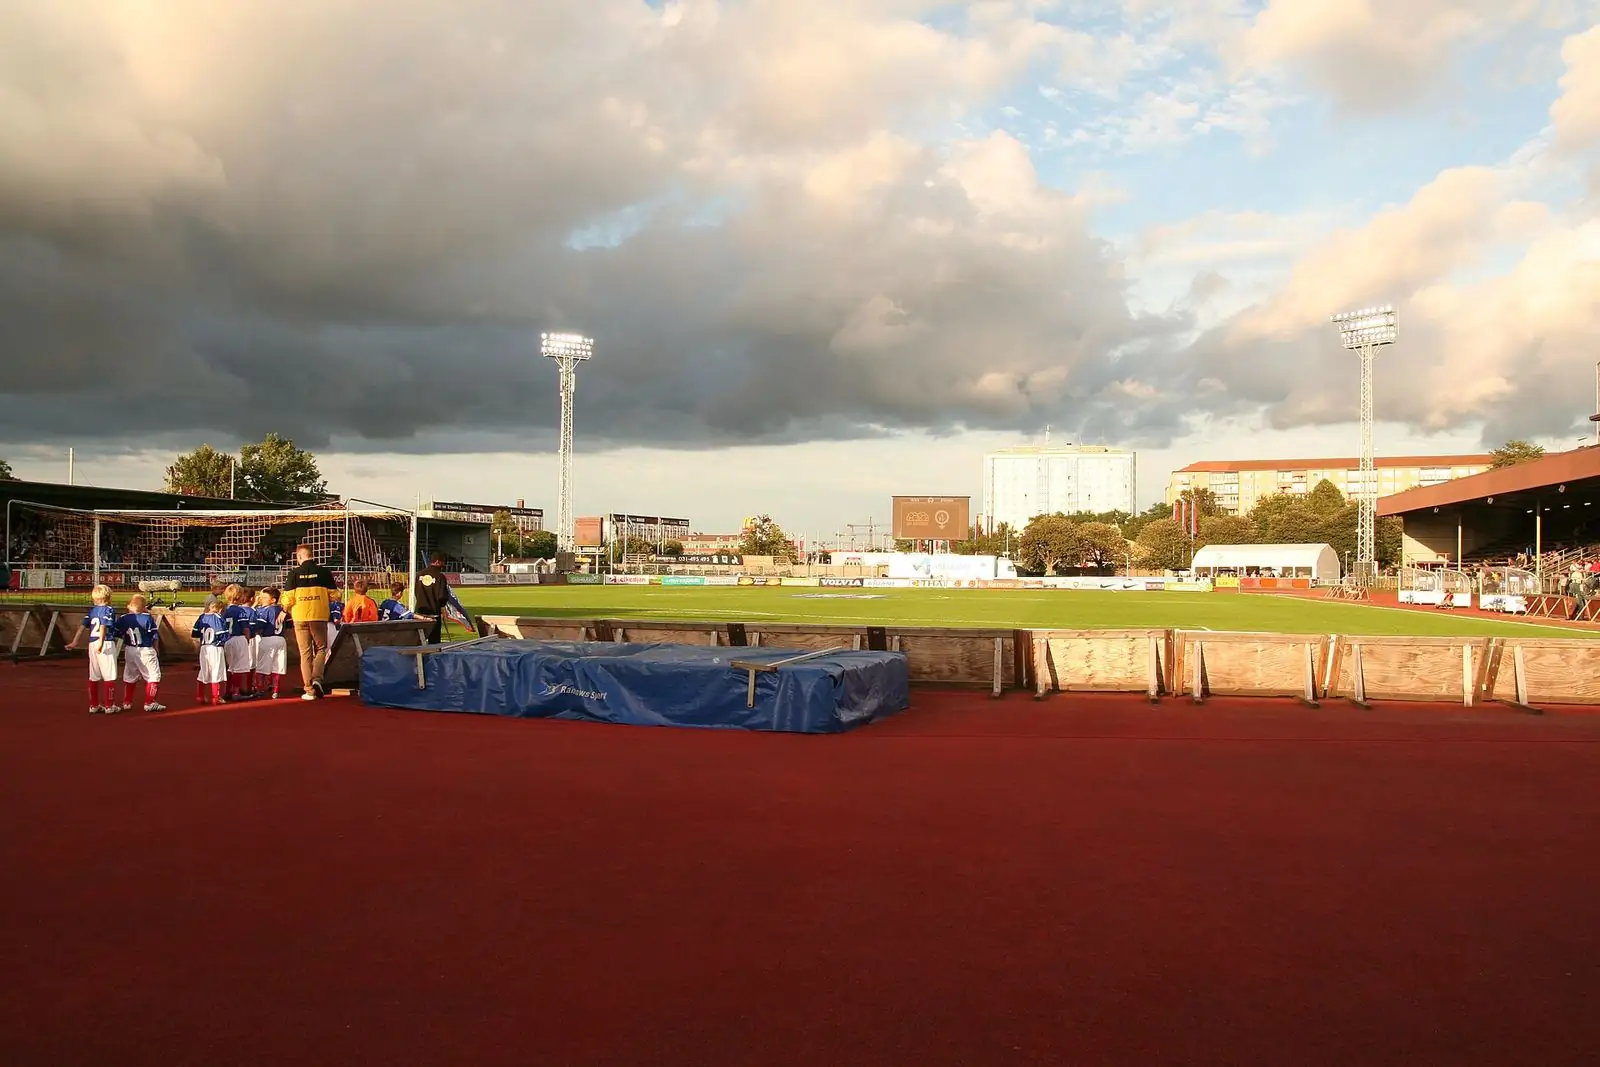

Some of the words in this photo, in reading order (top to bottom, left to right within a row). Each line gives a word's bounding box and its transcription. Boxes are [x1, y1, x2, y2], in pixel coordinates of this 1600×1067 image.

[820, 578, 862, 586] VOLVIA
[90, 617, 101, 638] 2
[126, 627, 143, 646] 11
[200, 626, 215, 645] 10
[590, 691, 608, 701] Sport
